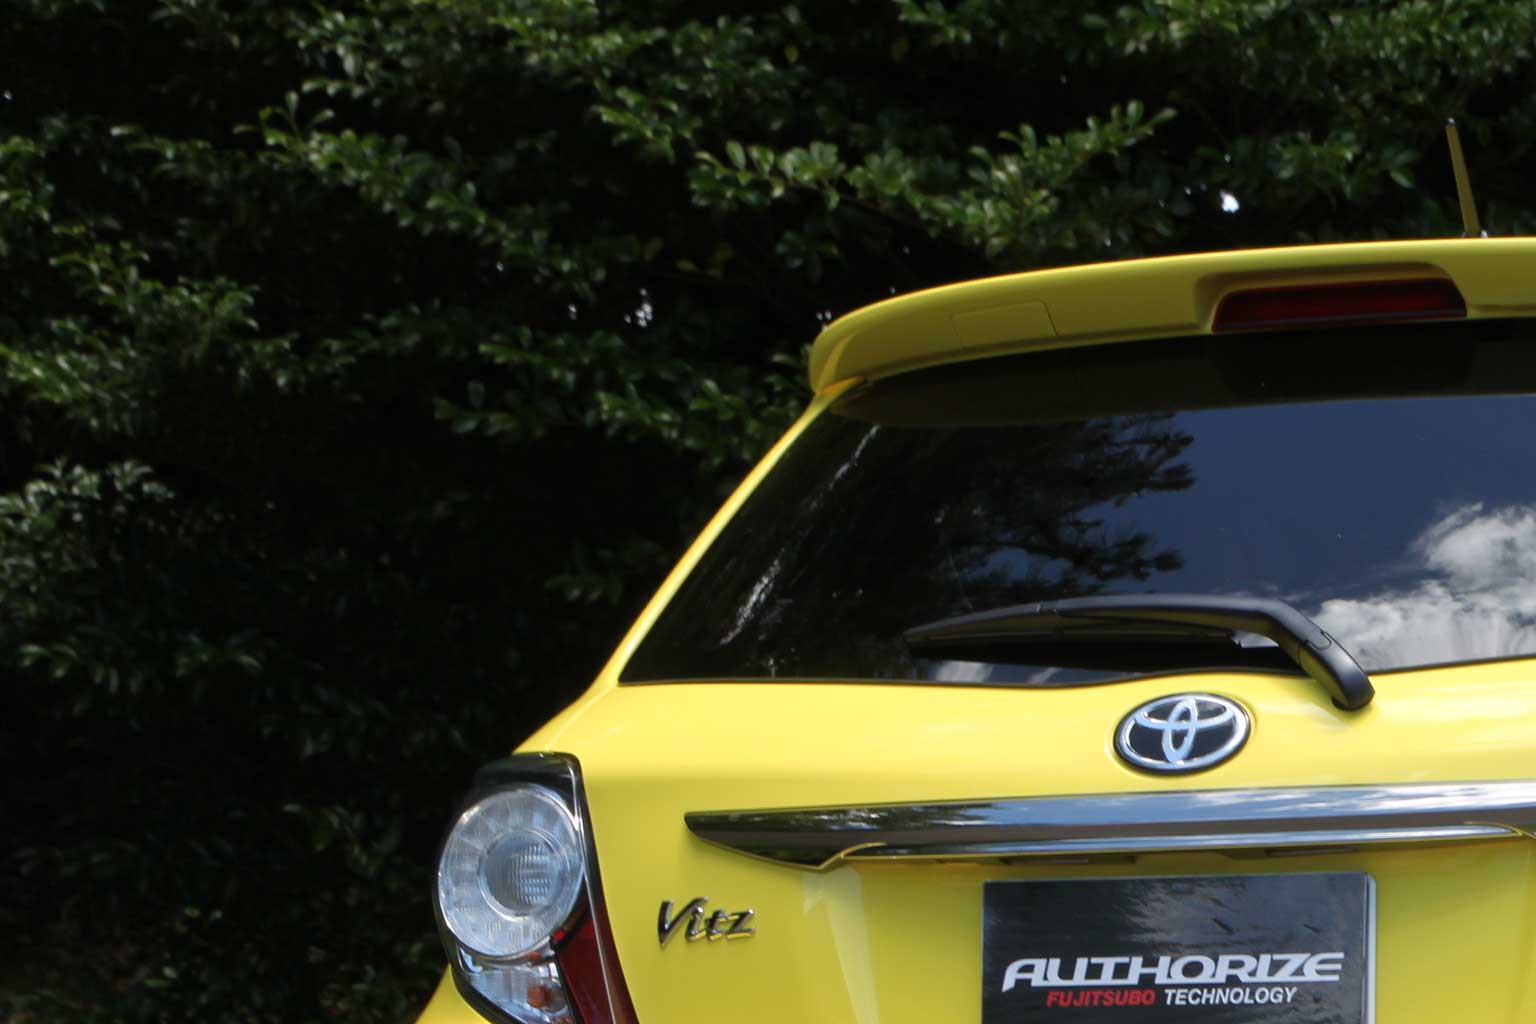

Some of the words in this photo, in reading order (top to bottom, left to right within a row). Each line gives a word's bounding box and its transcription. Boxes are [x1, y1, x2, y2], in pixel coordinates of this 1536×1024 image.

[658, 896, 756, 947] Vitz
[1002, 952, 1345, 992] AUTHORIZE
[1046, 989, 1156, 1007] FUJITSUBO
[1164, 986, 1298, 1006] TECHNOLOGY
